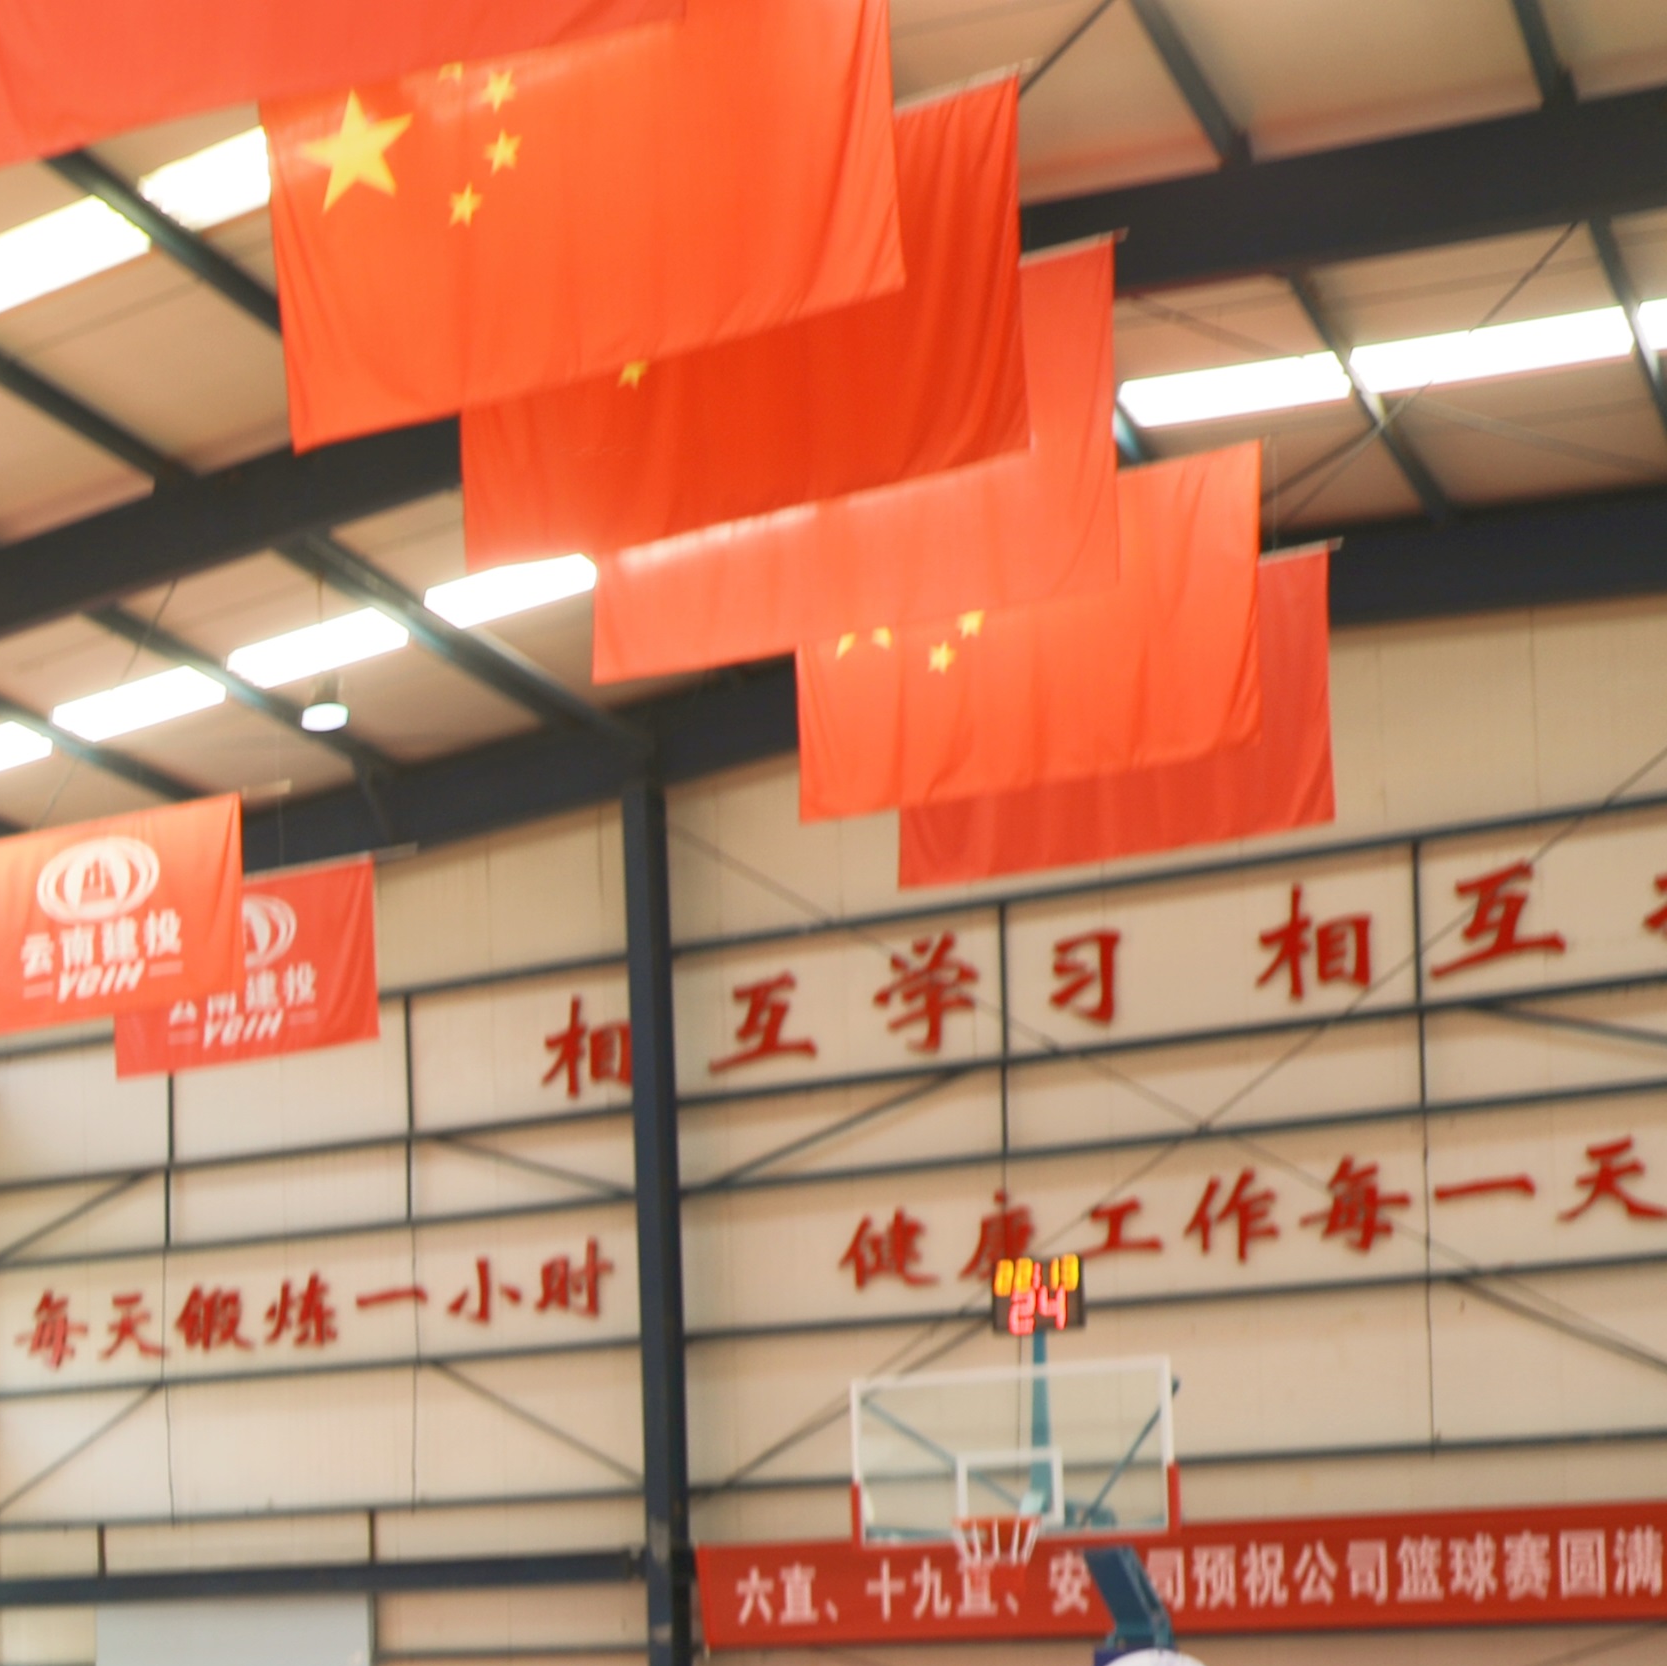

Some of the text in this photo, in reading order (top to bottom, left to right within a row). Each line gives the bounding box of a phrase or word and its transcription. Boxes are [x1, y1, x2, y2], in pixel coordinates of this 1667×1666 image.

[21, 909, 181, 979] 云南建投
[542, 856, 1667, 1102] 相互学习 相互
[57, 958, 145, 1003] YCIH
[204, 1008, 283, 1049] YCIH
[840, 1134, 1667, 1290] 健康工作每一天
[16, 1237, 614, 1372] 每天锻炼一小时
[1008, 1284, 1067, 1337] 24
